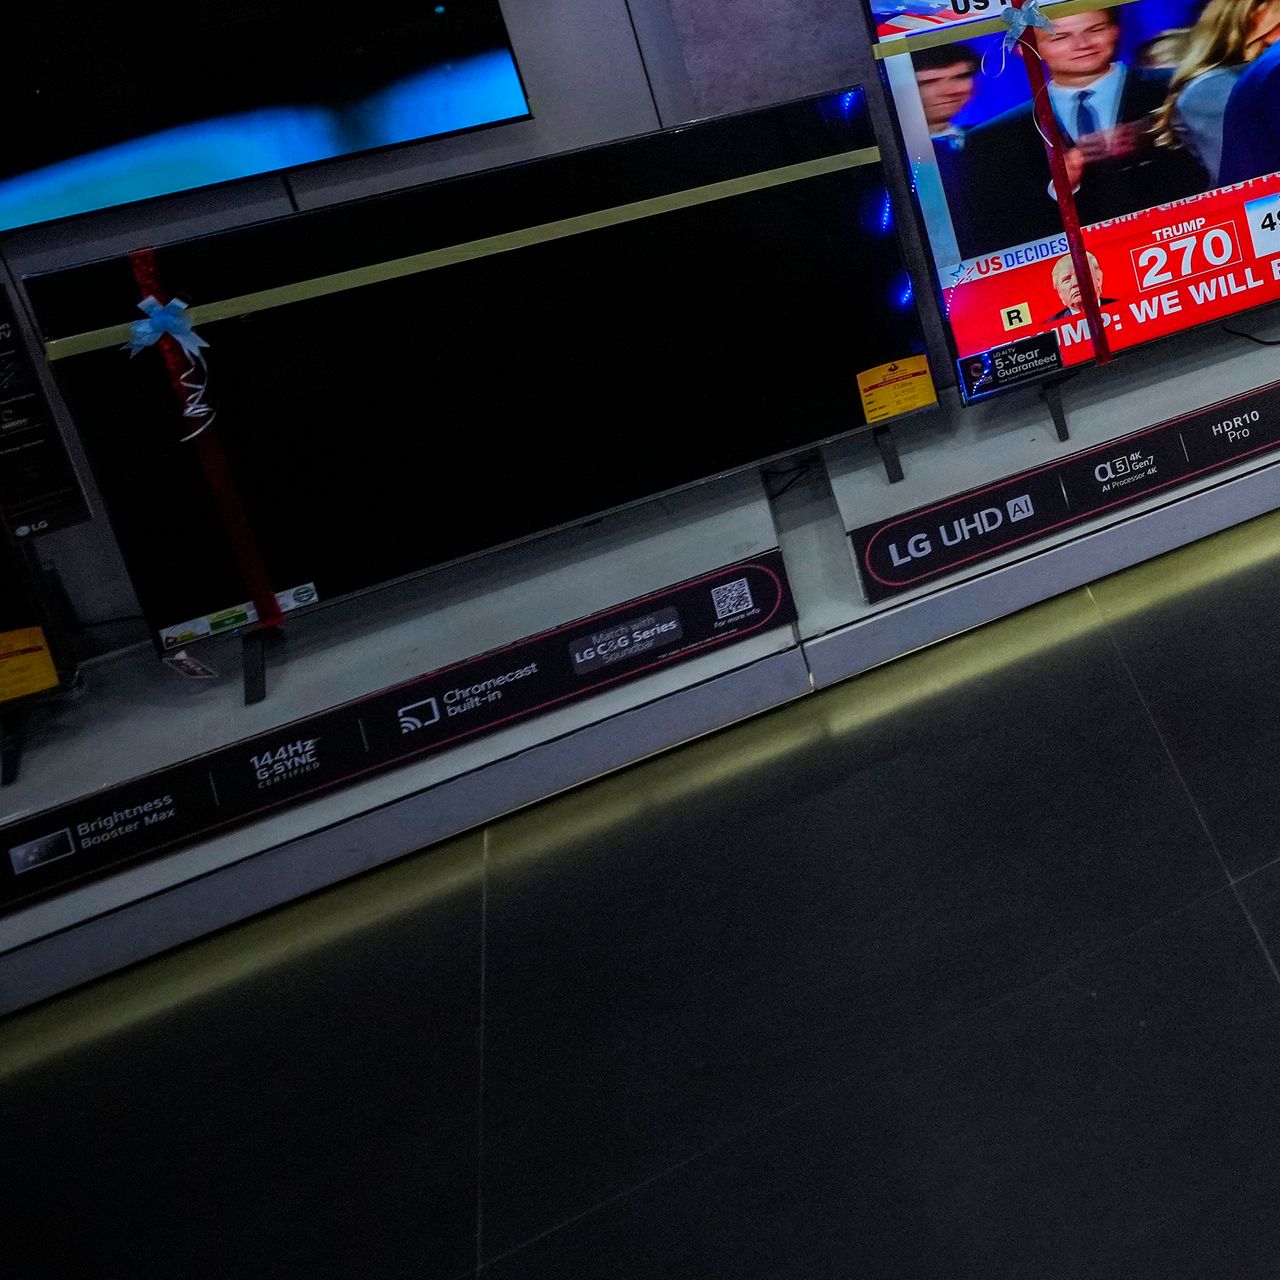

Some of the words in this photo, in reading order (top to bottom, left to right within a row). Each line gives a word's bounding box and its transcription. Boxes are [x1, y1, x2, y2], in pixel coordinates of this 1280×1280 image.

[1152, 217, 1206, 242] TRUMP
[976, 255, 1003, 276] US
[1004, 236, 1069, 269] DECIDES
[1137, 228, 1233, 289] 270
[1129, 290, 1182, 324] WE
[1188, 268, 1264, 306] WILL
[1006, 309, 1023, 326] R
[995, 349, 1040, 370] 5-Year
[997, 353, 1057, 378] Guaranteed
[1211, 410, 1260, 436] HDR10
[1227, 426, 1251, 443] Pro
[1131, 455, 1154, 473] Gen7
[1101, 482, 1111, 493] AI
[1111, 471, 1145, 490] Processor
[1146, 466, 1158, 478] 4K
[31, 520, 48, 533] LG
[888, 532, 932, 567] LG
[939, 507, 1003, 547] UHD
[1010, 497, 1032, 521] AI
[574, 647, 595, 664] LG
[632, 619, 677, 643] Series
[591, 622, 630, 645] Match
[630, 615, 656, 635] with
[601, 638, 656, 665] Soundbar
[443, 662, 539, 705] Chromecast
[445, 688, 503, 718] built-in
[250, 738, 316, 770] 144Hz
[256, 752, 317, 781] G-SYNC
[257, 761, 321, 790] CERTIFIED
[76, 794, 173, 837] Brightness
[80, 818, 140, 850] Booster
[143, 808, 176, 827] Max
